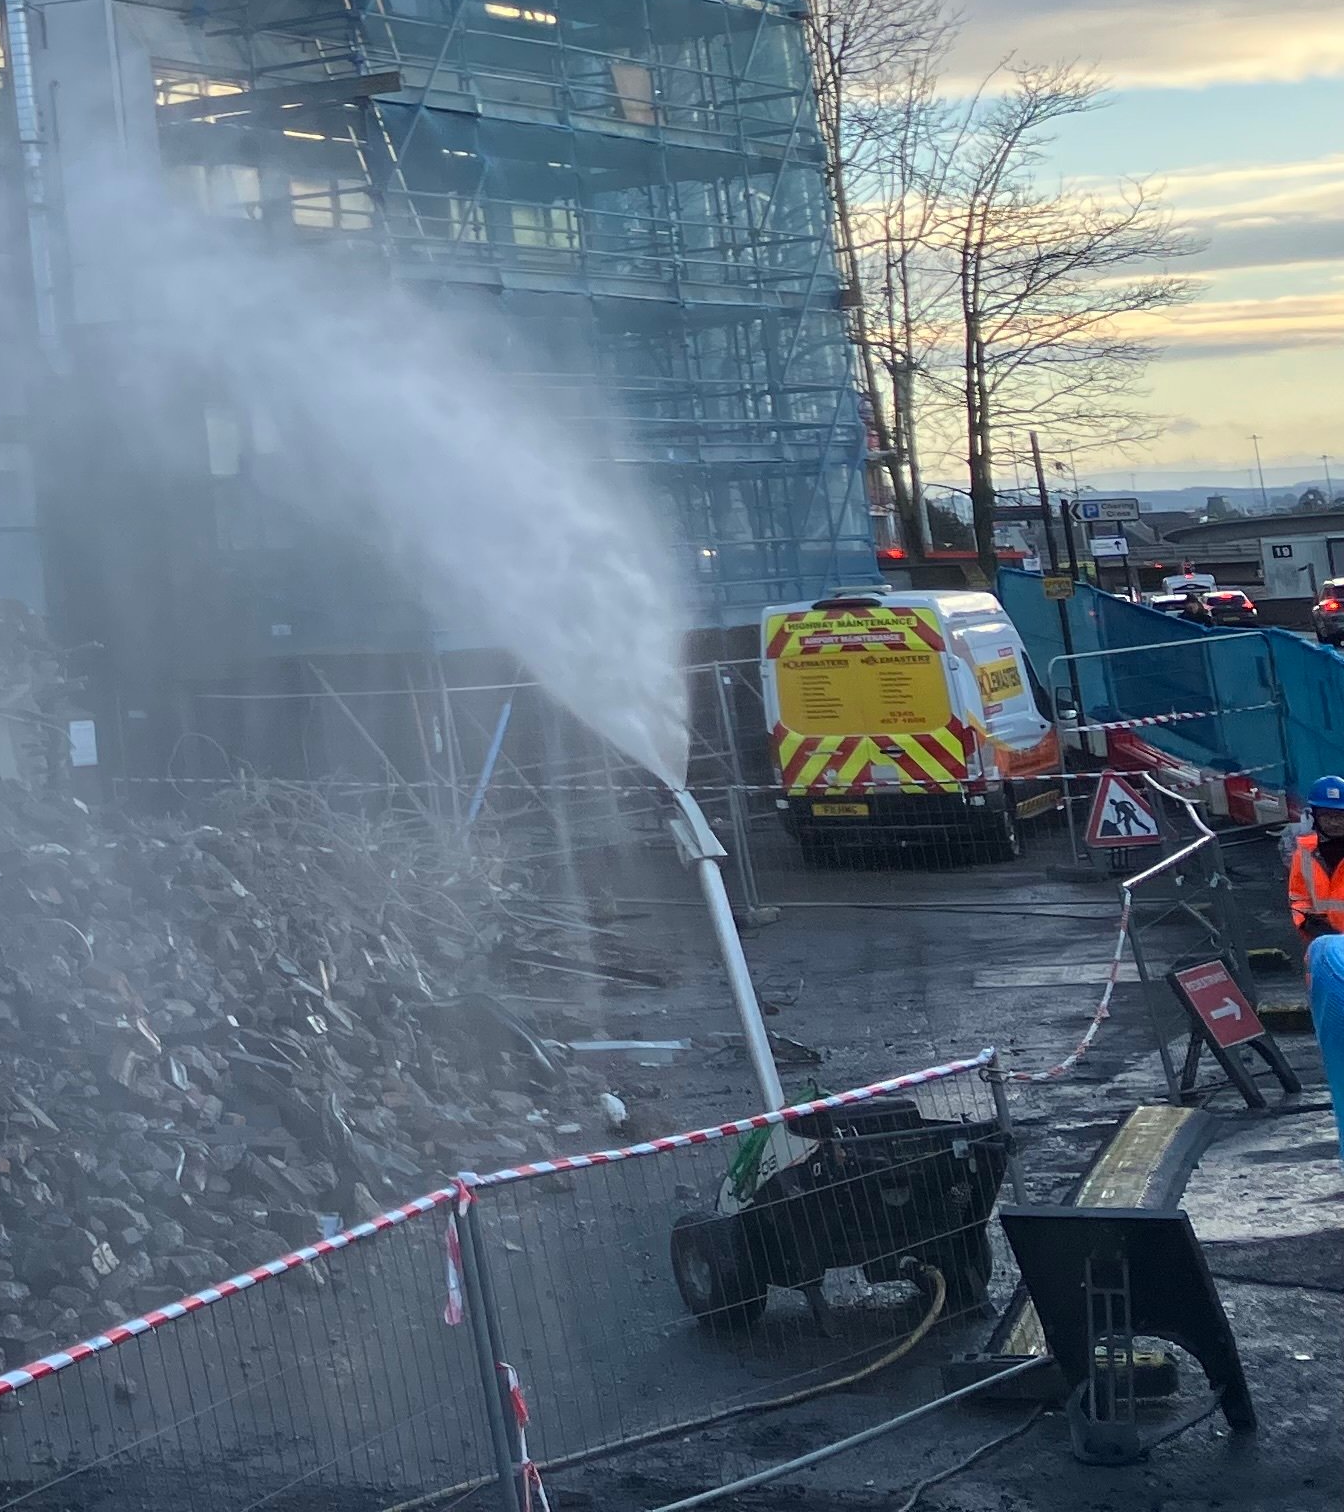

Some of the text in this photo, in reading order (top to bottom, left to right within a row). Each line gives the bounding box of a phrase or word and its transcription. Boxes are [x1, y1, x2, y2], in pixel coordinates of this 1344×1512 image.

[1275, 546, 1290, 556] 19
[788, 617, 913, 631] HIGHWAY MAINTENANCE
[841, 634, 900, 644] MAINTENANCE
